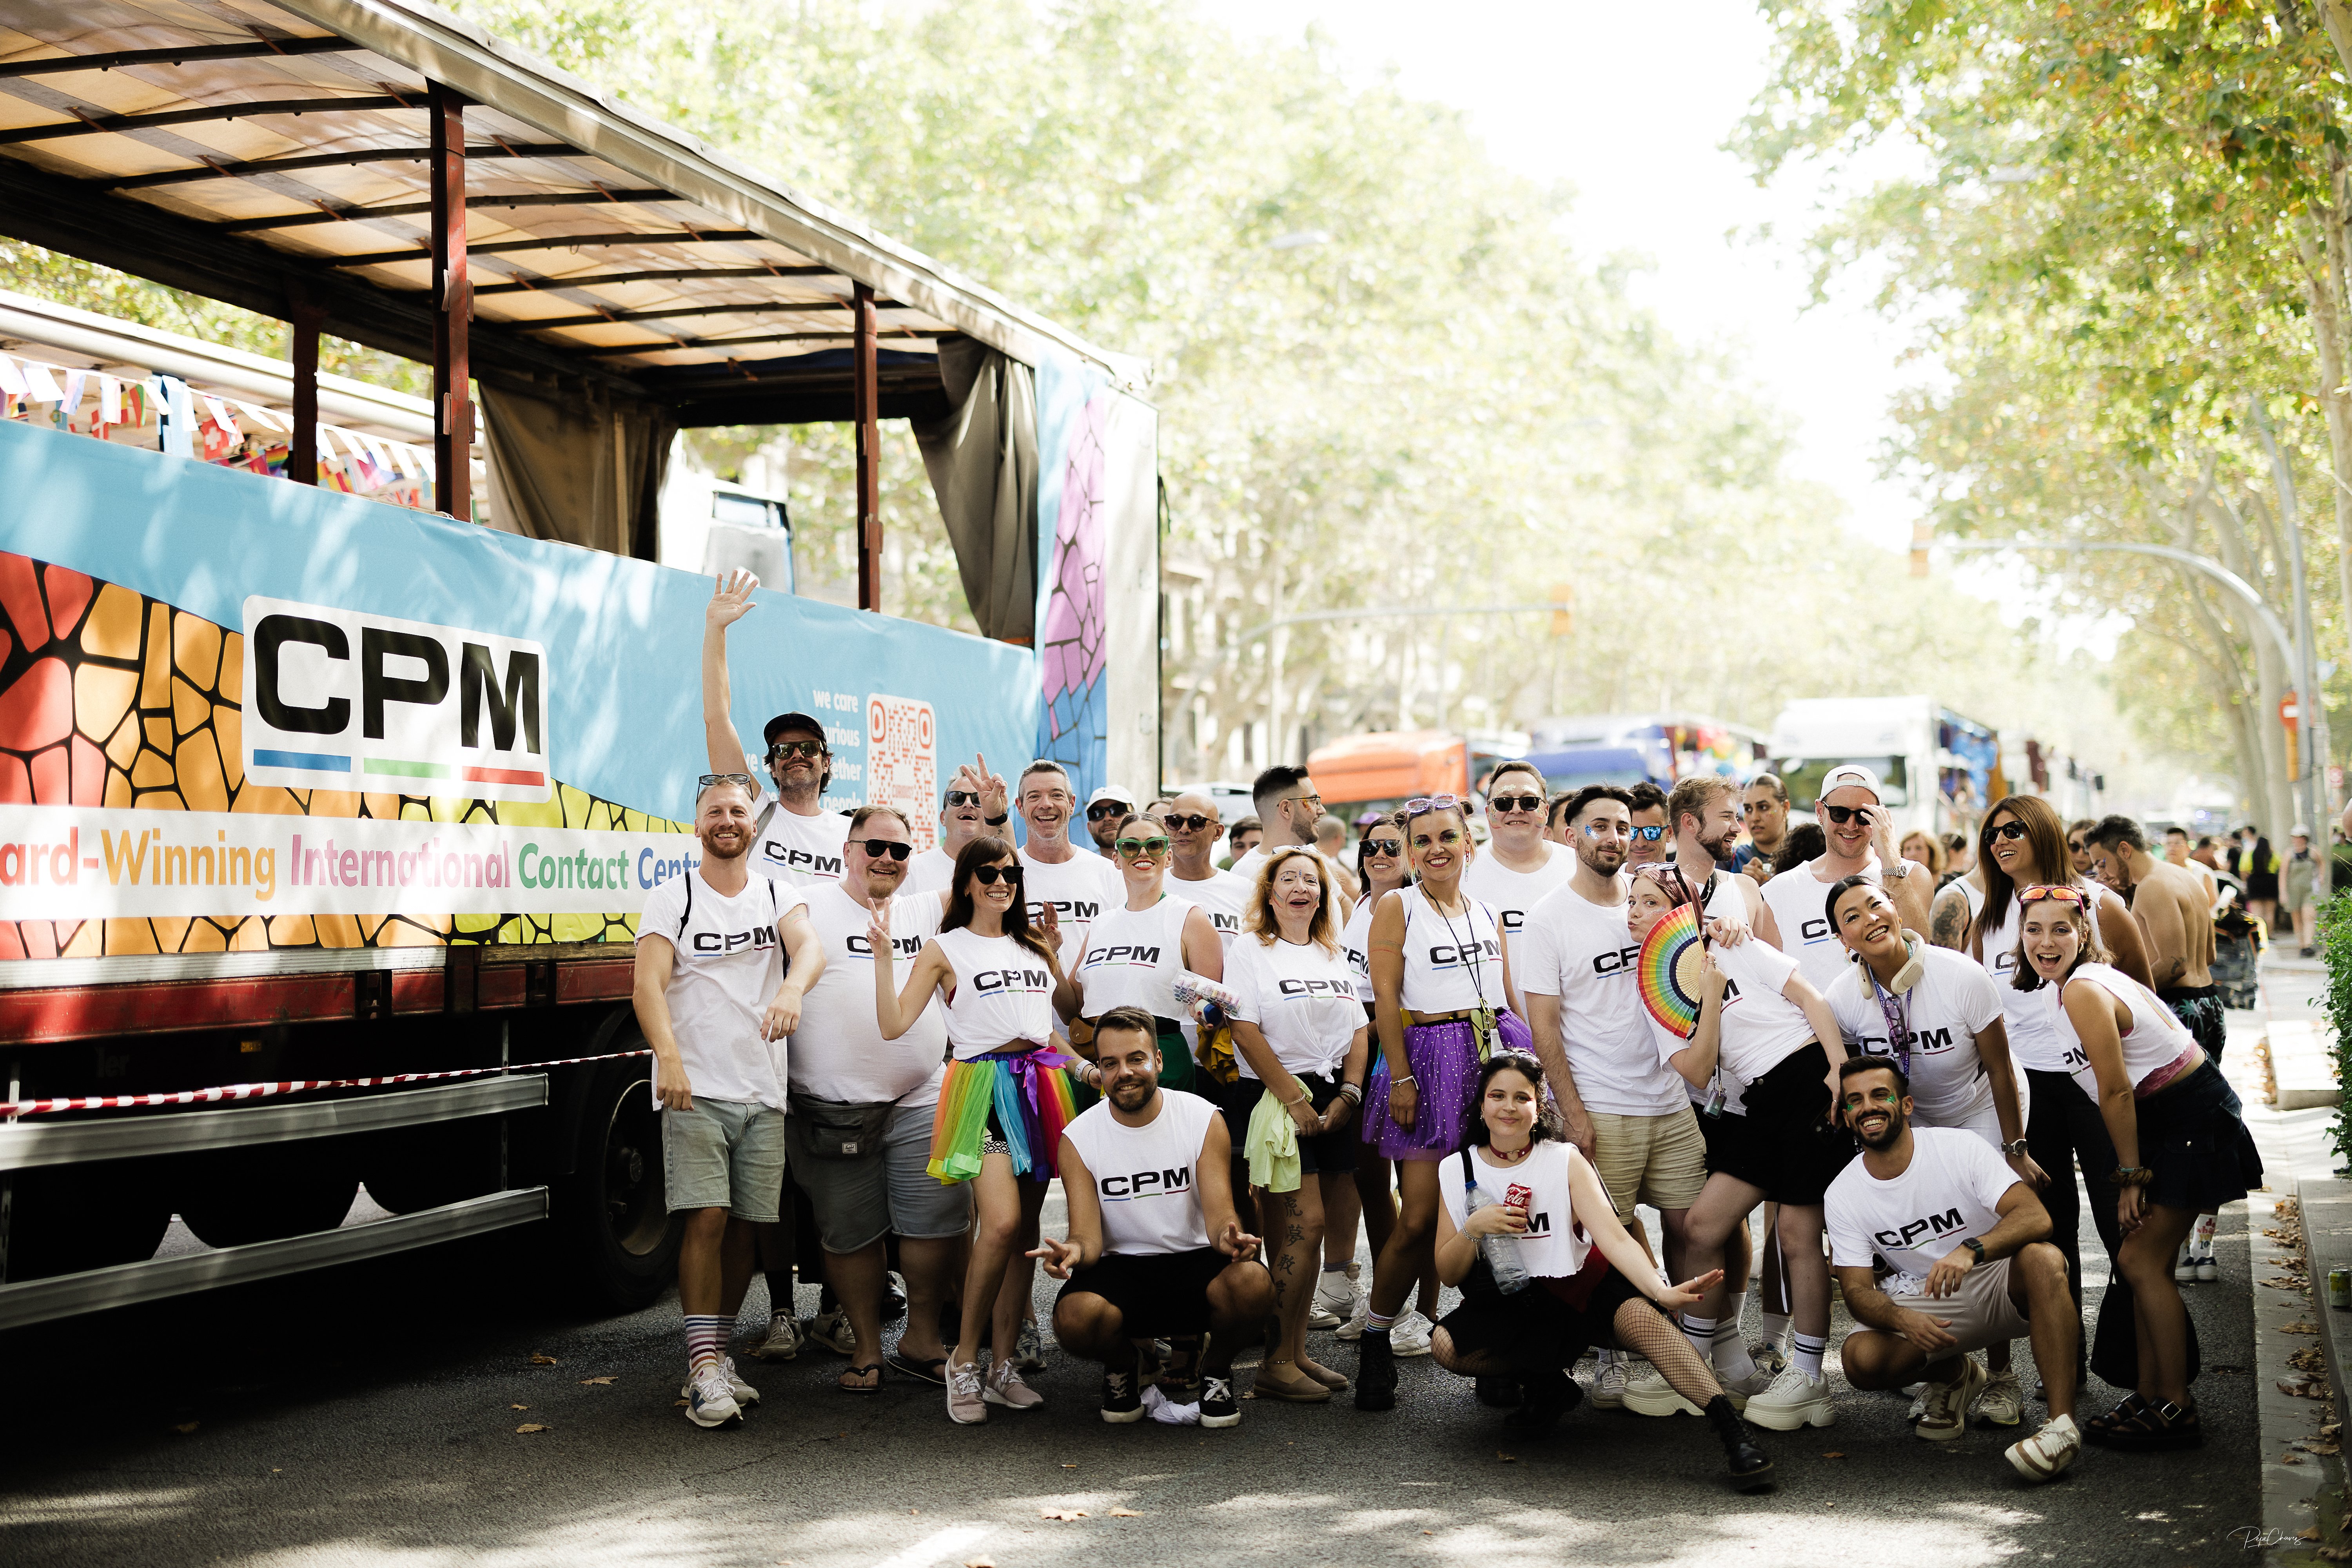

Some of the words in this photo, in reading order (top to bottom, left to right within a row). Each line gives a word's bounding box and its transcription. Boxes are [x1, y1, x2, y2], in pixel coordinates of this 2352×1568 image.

[254, 614, 541, 755] CPM
[813, 690, 831, 709] we
[833, 693, 858, 713] care
[822, 720, 860, 747] urious
[291, 834, 510, 888] International
[519, 842, 630, 890] Contact
[765, 840, 841, 873] CPM
[694, 926, 775, 951] CPM
[1086, 946, 1160, 965] CPM
[1593, 945, 1641, 973] CP
[974, 970, 1047, 991] CPM
[1279, 979, 1354, 996] CPM
[1101, 1167, 1190, 1196] CPM
[1875, 1208, 1964, 1247] CPM
